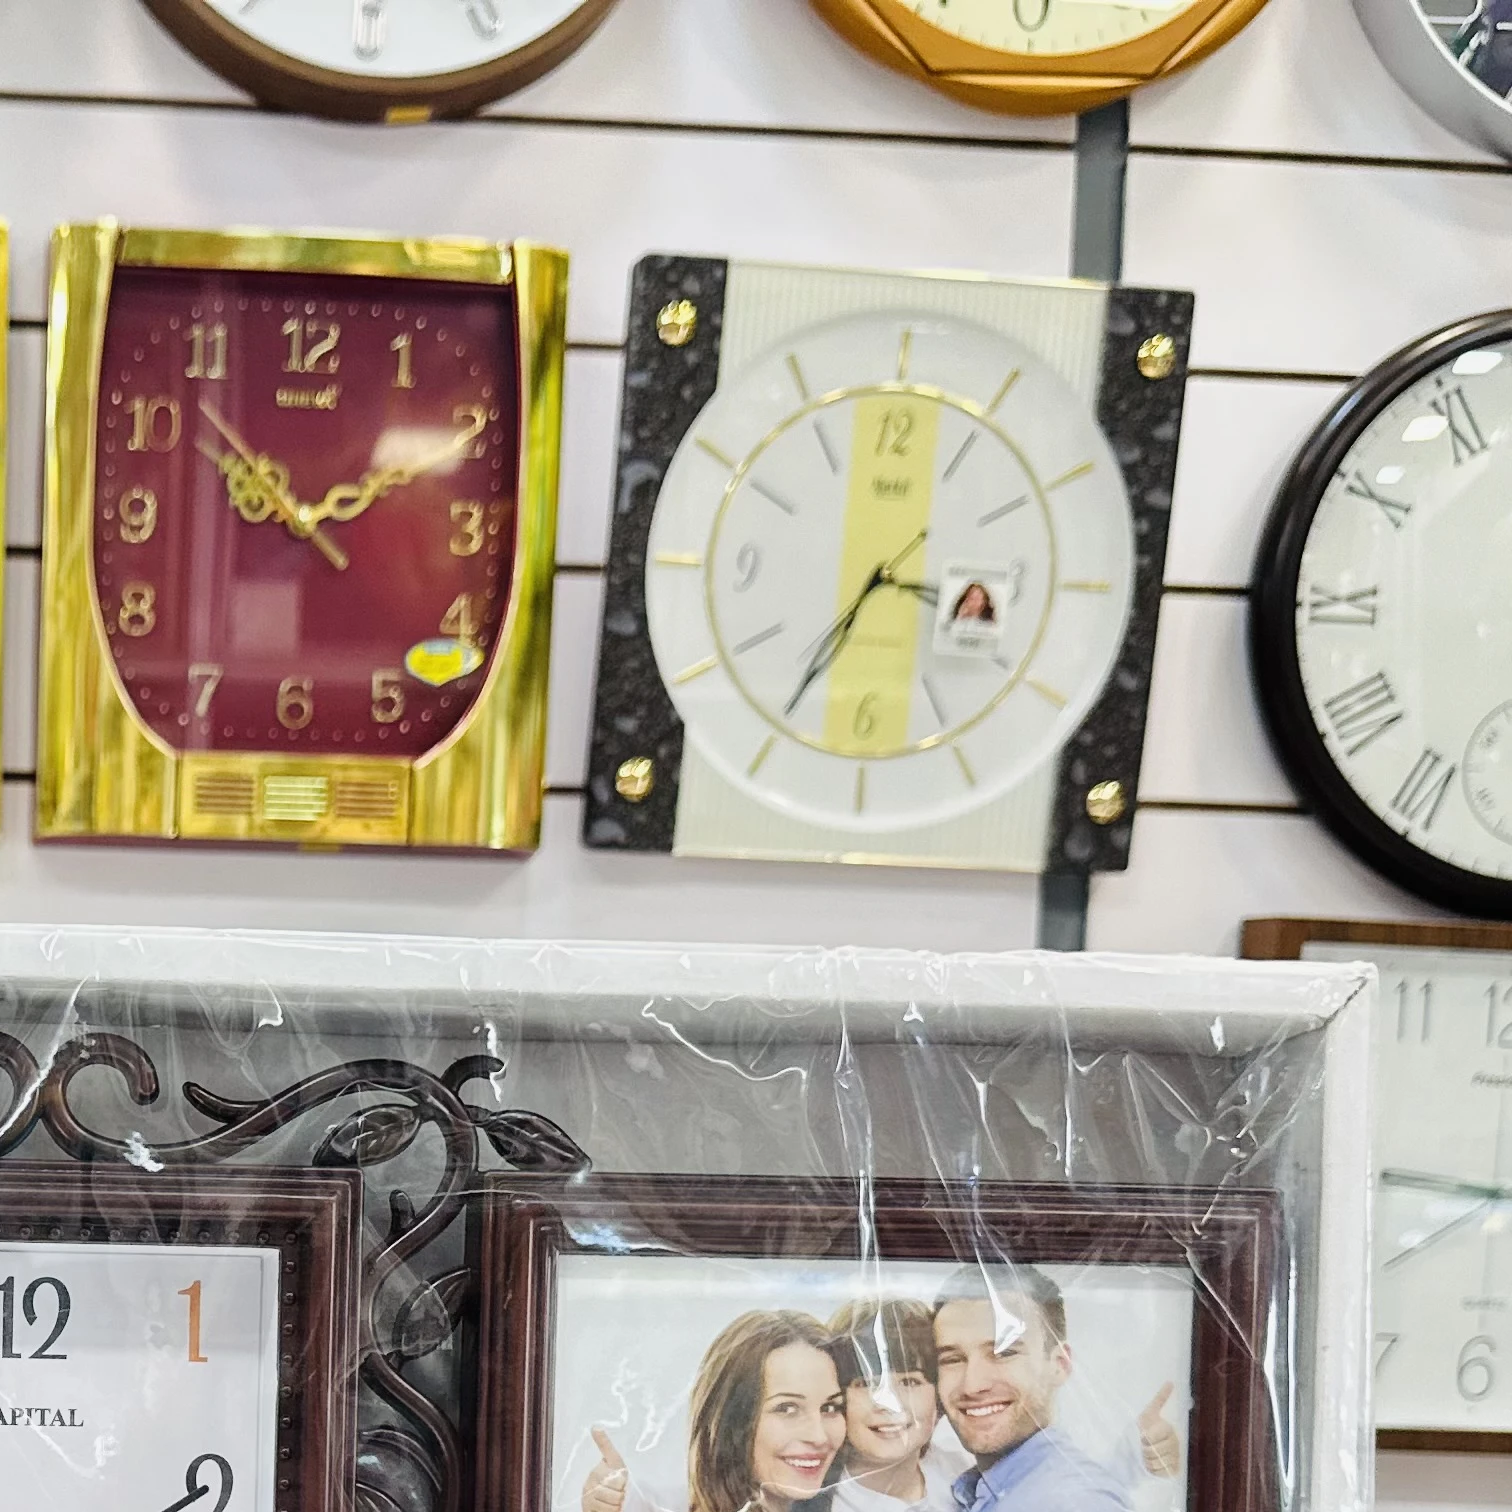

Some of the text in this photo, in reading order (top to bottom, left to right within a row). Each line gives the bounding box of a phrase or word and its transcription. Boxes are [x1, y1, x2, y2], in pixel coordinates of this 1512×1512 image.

[185, 324, 227, 380] 11
[281, 317, 341, 373] 12
[391, 333, 416, 388] 1
[124, 398, 181, 452] 10
[452, 403, 487, 458] 2
[874, 409, 912, 456] 12
[120, 489, 158, 543] 9
[1347, 470, 1412, 528] X
[449, 502, 484, 556] 3
[733, 542, 761, 591] 9
[119, 582, 156, 636] 8
[439, 593, 478, 647] 4
[189, 664, 223, 716] 7
[277, 678, 313, 729] 6
[372, 668, 405, 723] 5
[854, 691, 879, 738] 6
[1397, 979, 1433, 1042] 11
[177, 1280, 208, 1362] 1
[1456, 1335, 1496, 1401] 6
